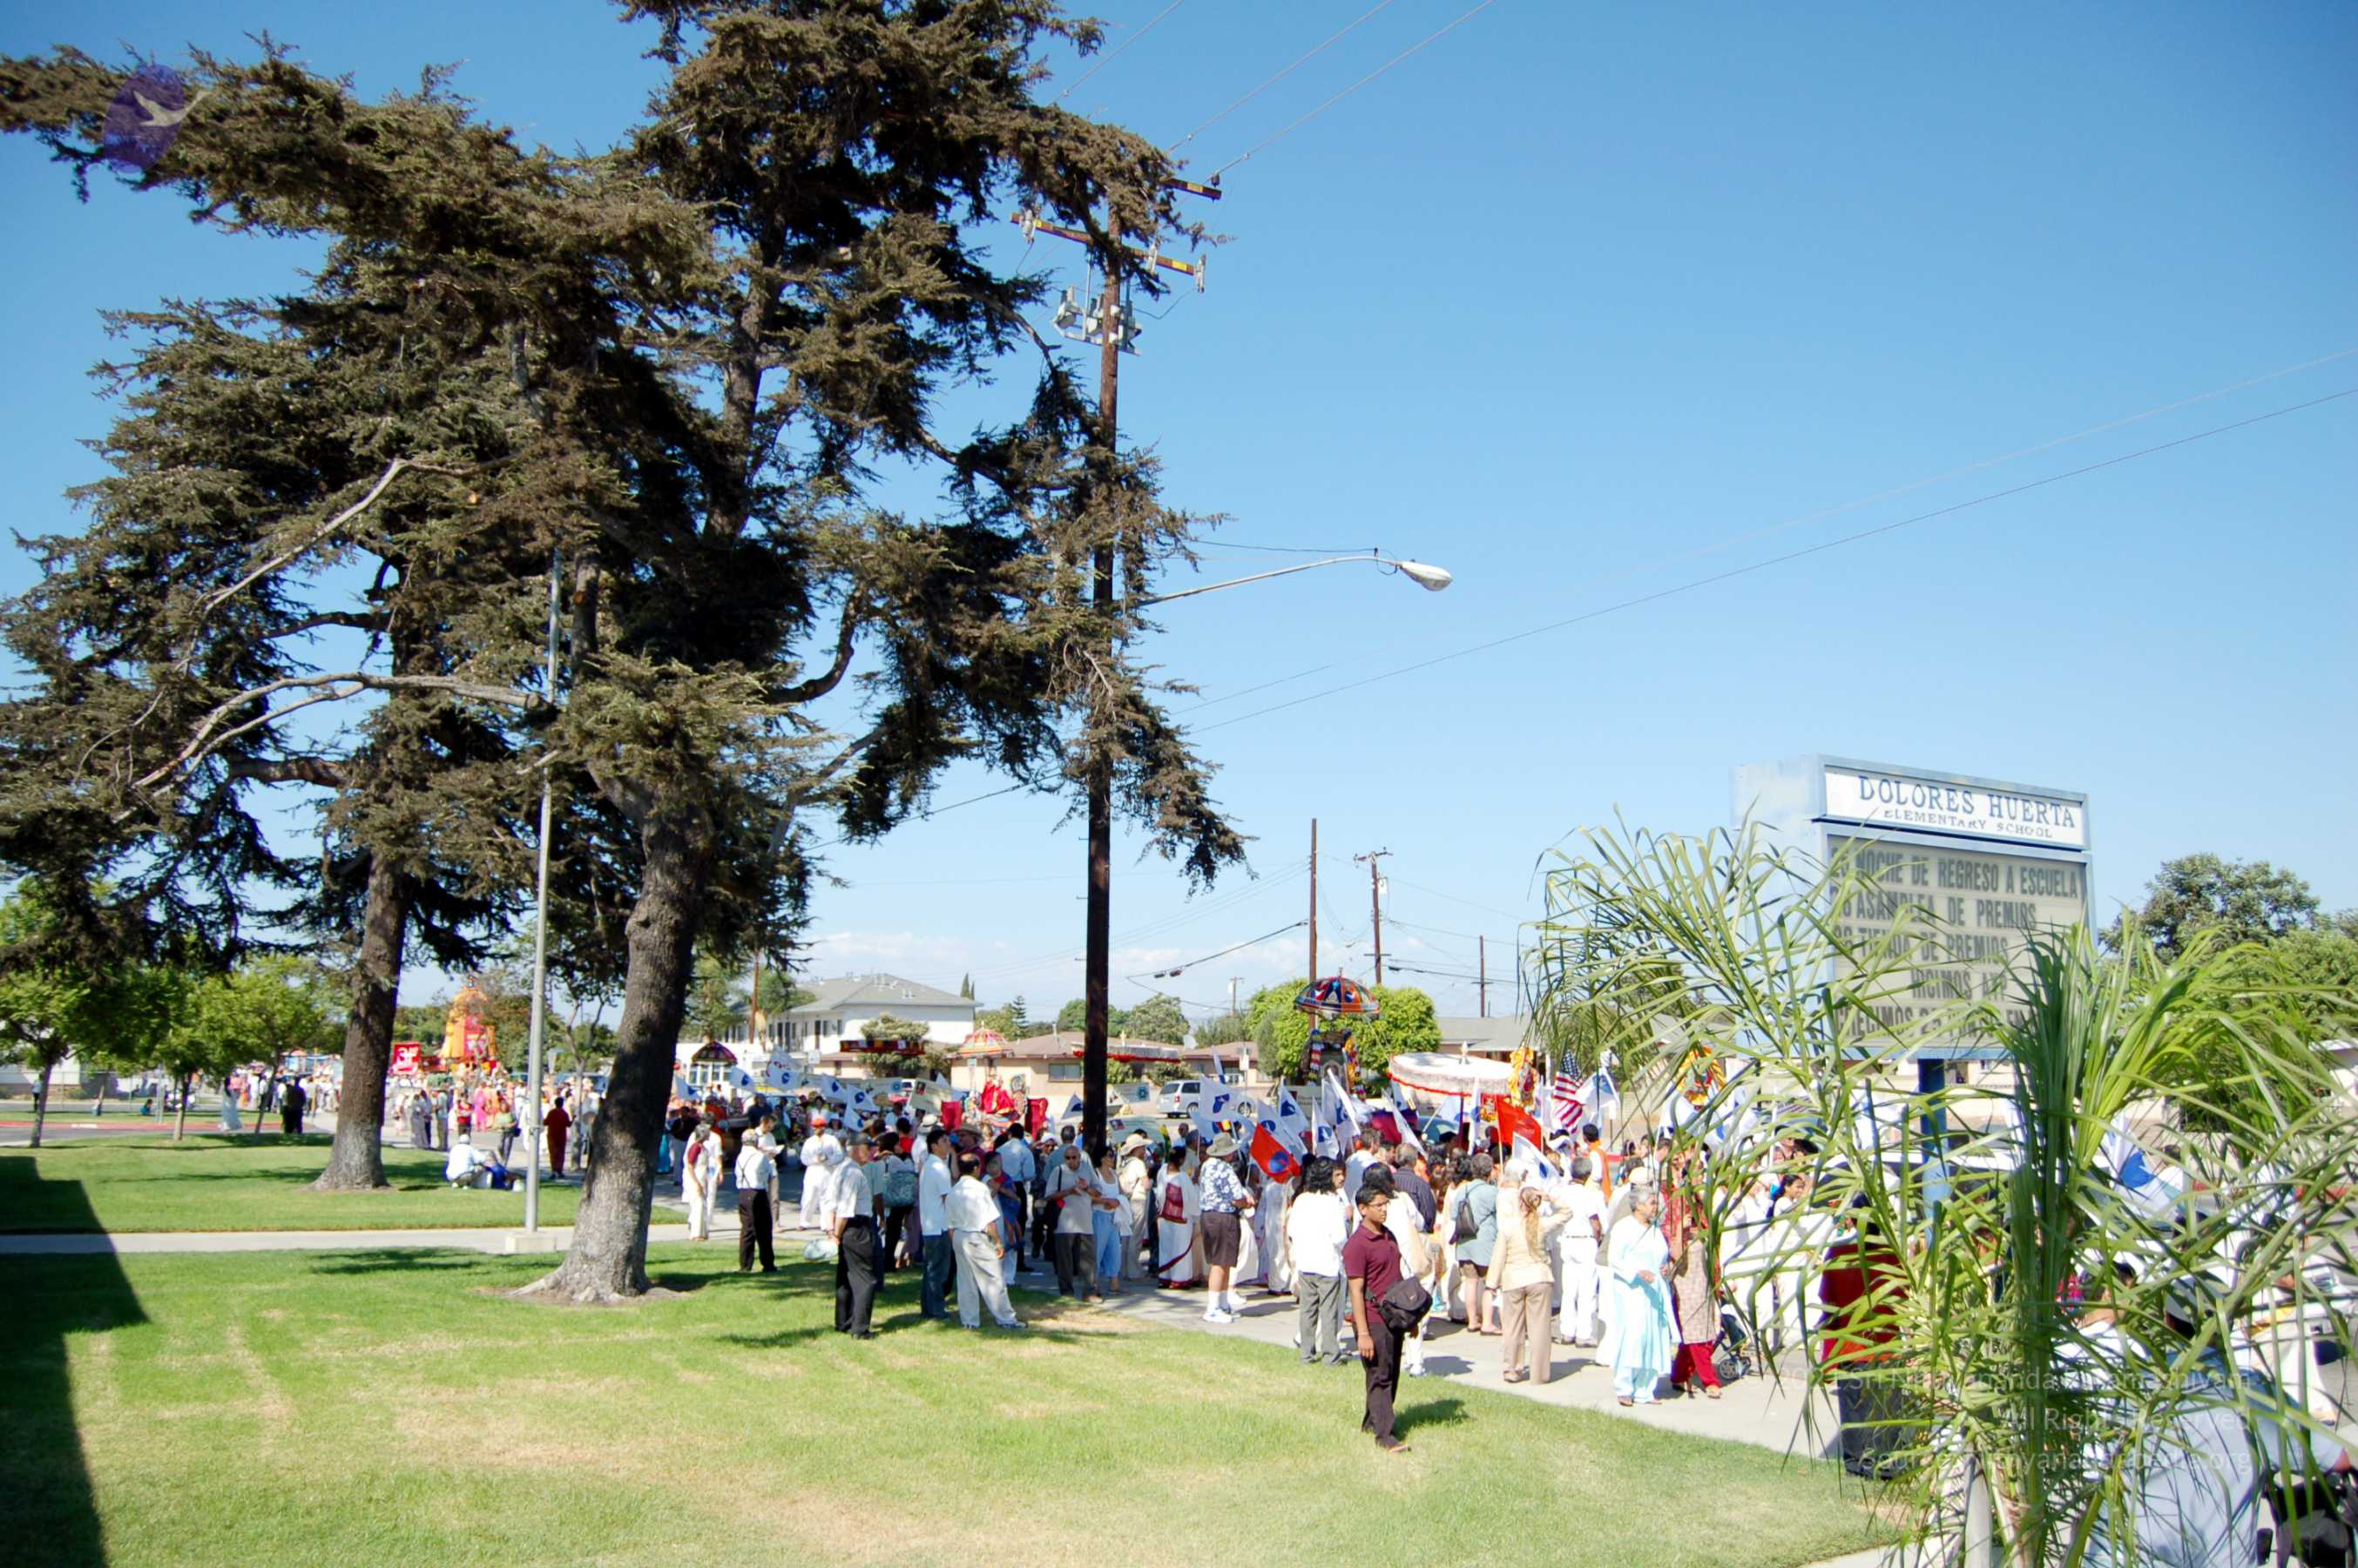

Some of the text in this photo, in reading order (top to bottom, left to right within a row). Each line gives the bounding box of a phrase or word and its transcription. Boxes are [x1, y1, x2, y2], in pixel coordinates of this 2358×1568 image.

[1858, 774, 2076, 828] DOLORES HUERTA
[1883, 808, 2053, 839] ELEMENTARY SCHOOL
[1855, 848, 1903, 883] NOCHE
[1910, 854, 1930, 887] DE
[1937, 857, 1999, 893] REGRESO
[2005, 865, 2015, 895] A
[2020, 866, 2078, 899] ESCUELA
[1948, 896, 1966, 927] DE
[1976, 899, 2037, 930] PREMIOS
[1920, 932, 1939, 962] DE
[1947, 934, 2008, 966] PREMIOS
